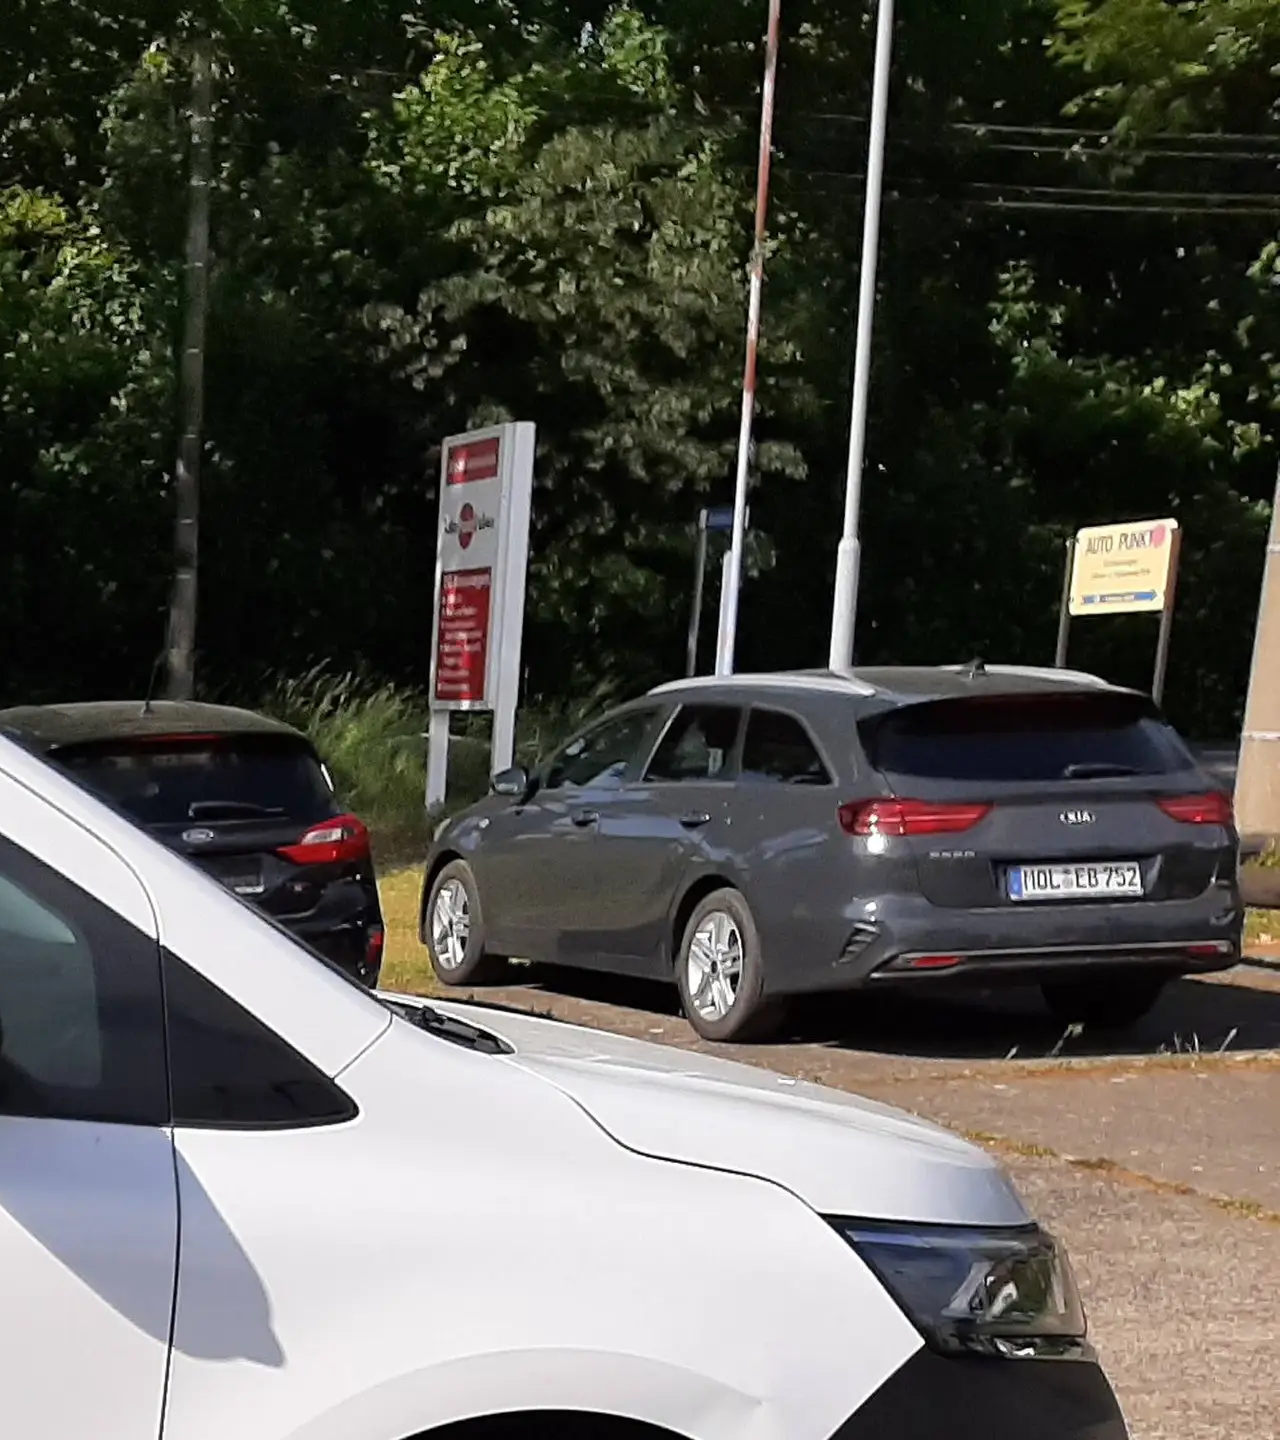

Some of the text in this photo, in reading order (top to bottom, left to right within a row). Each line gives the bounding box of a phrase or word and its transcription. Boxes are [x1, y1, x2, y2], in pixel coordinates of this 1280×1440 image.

[1085, 535, 1113, 555] AUTO
[1066, 810, 1091, 823] KIA
[1023, 867, 1061, 891] MOL
[1104, 866, 1138, 887] 752
